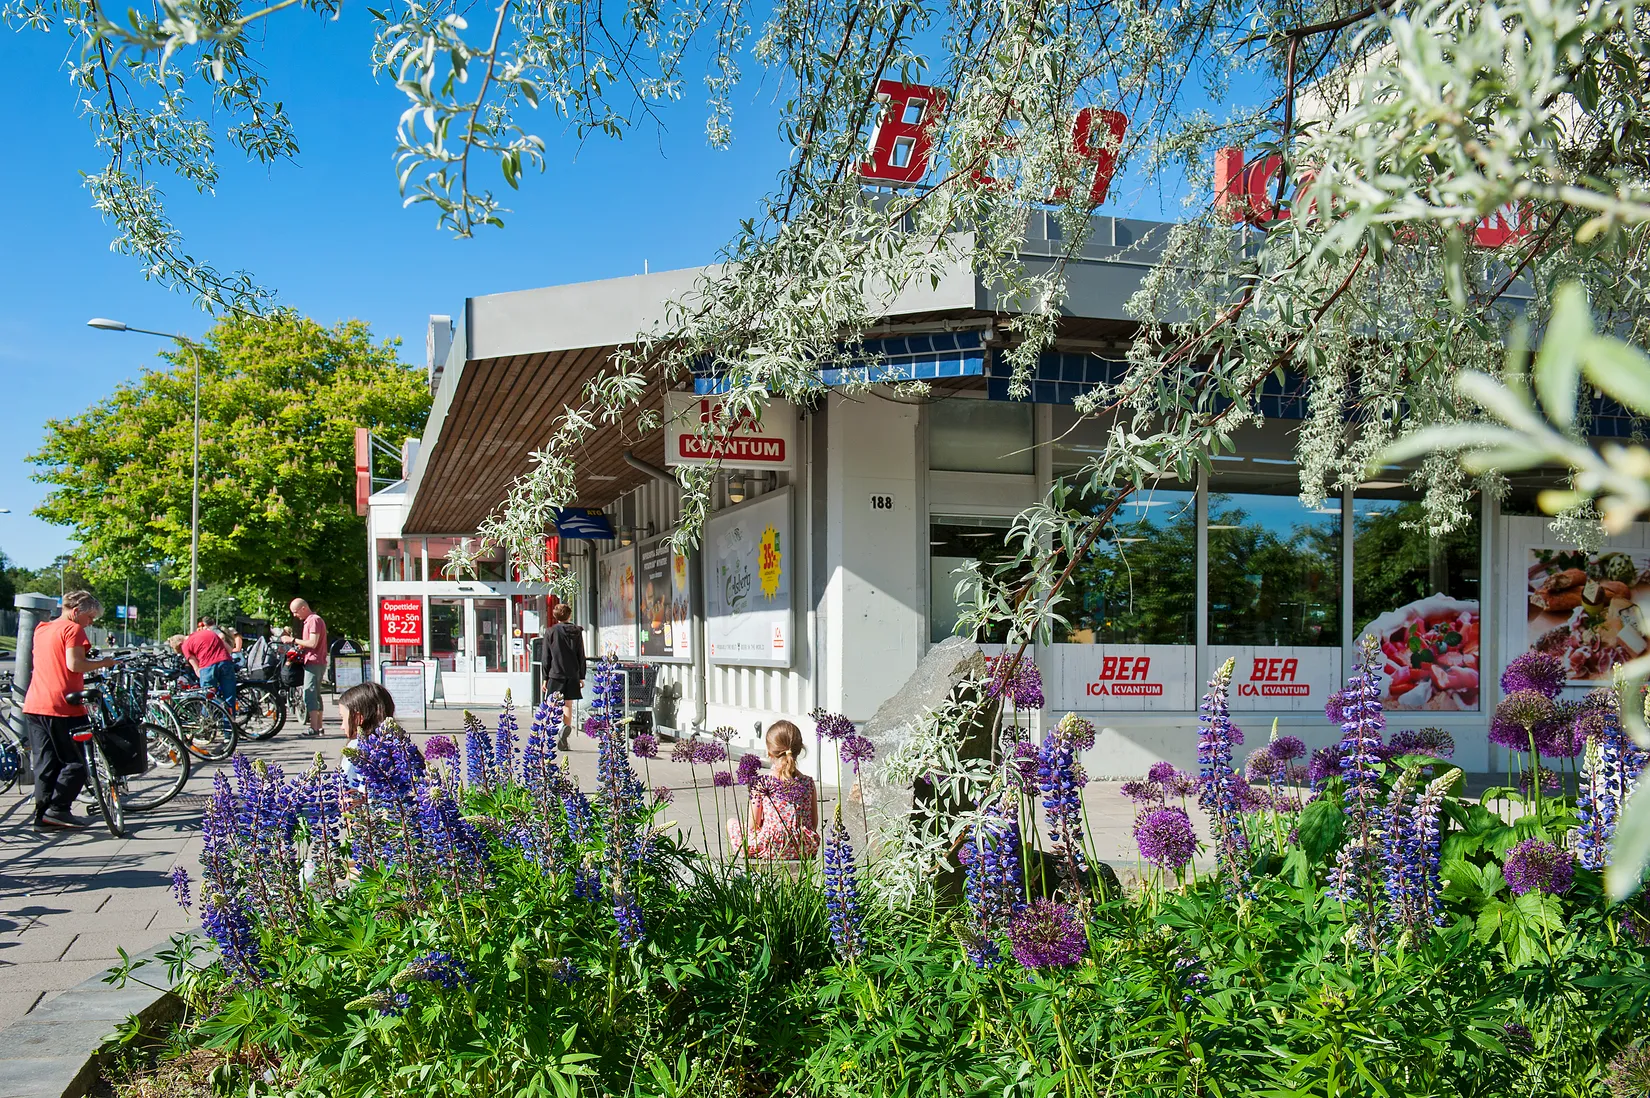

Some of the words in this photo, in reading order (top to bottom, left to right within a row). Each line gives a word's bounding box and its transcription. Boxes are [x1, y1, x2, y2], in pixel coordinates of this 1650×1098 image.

[685, 439, 780, 456] KVANTUM
[872, 496, 892, 509] 188
[383, 602, 419, 611] Öppettider
[383, 613, 400, 621] Mån
[405, 613, 420, 621] Sön
[387, 621, 416, 634] 8-22
[1099, 656, 1151, 681] BEA
[1250, 658, 1299, 682] BEA
[1087, 683, 1109, 696] ICA
[1113, 685, 1161, 695] KVANTUM
[1238, 684, 1259, 697] ICA
[1262, 686, 1308, 695] KVANTUM
